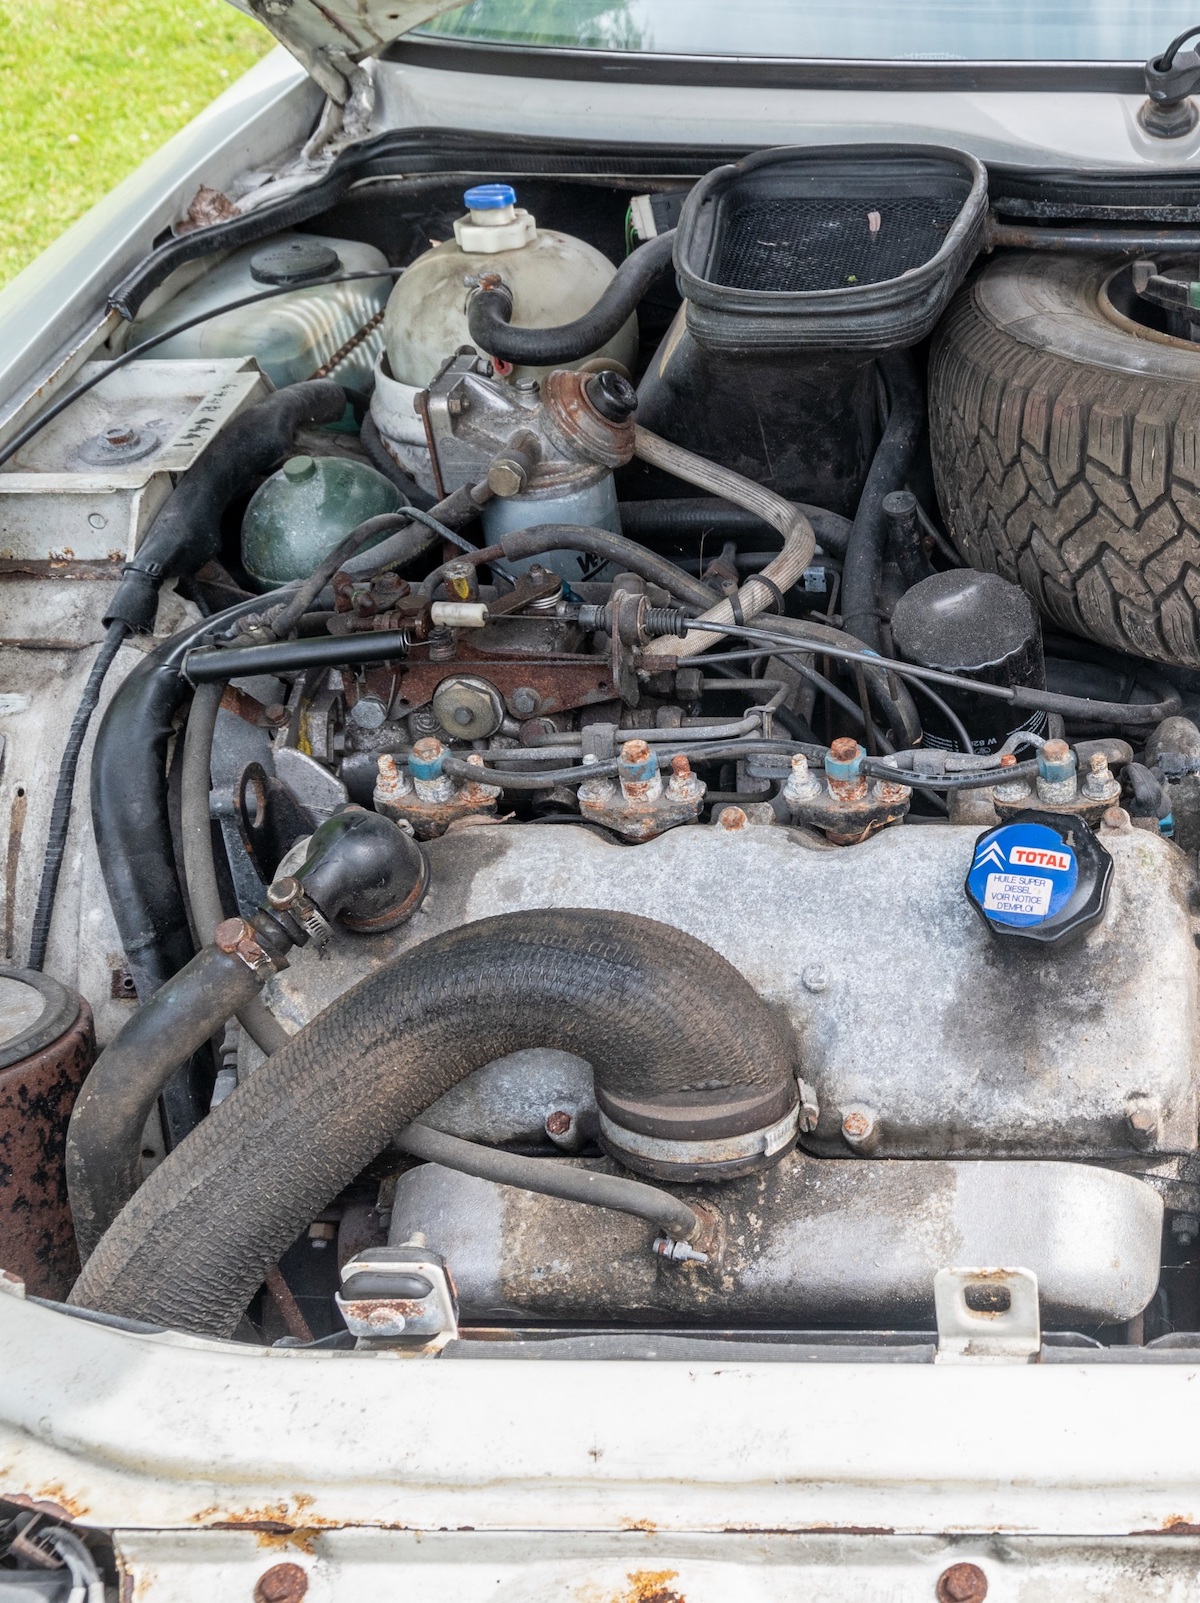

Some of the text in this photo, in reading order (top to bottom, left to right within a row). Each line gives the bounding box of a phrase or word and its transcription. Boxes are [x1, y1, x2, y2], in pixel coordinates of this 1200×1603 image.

[1016, 850, 1067, 869] TOTAL
[993, 874, 1046, 887] HUILE SUPER
[1004, 884, 1032, 895] DIESEL
[991, 892, 1043, 905] VOIR NOTICE
[996, 901, 1034, 913] D'EMPLOI
